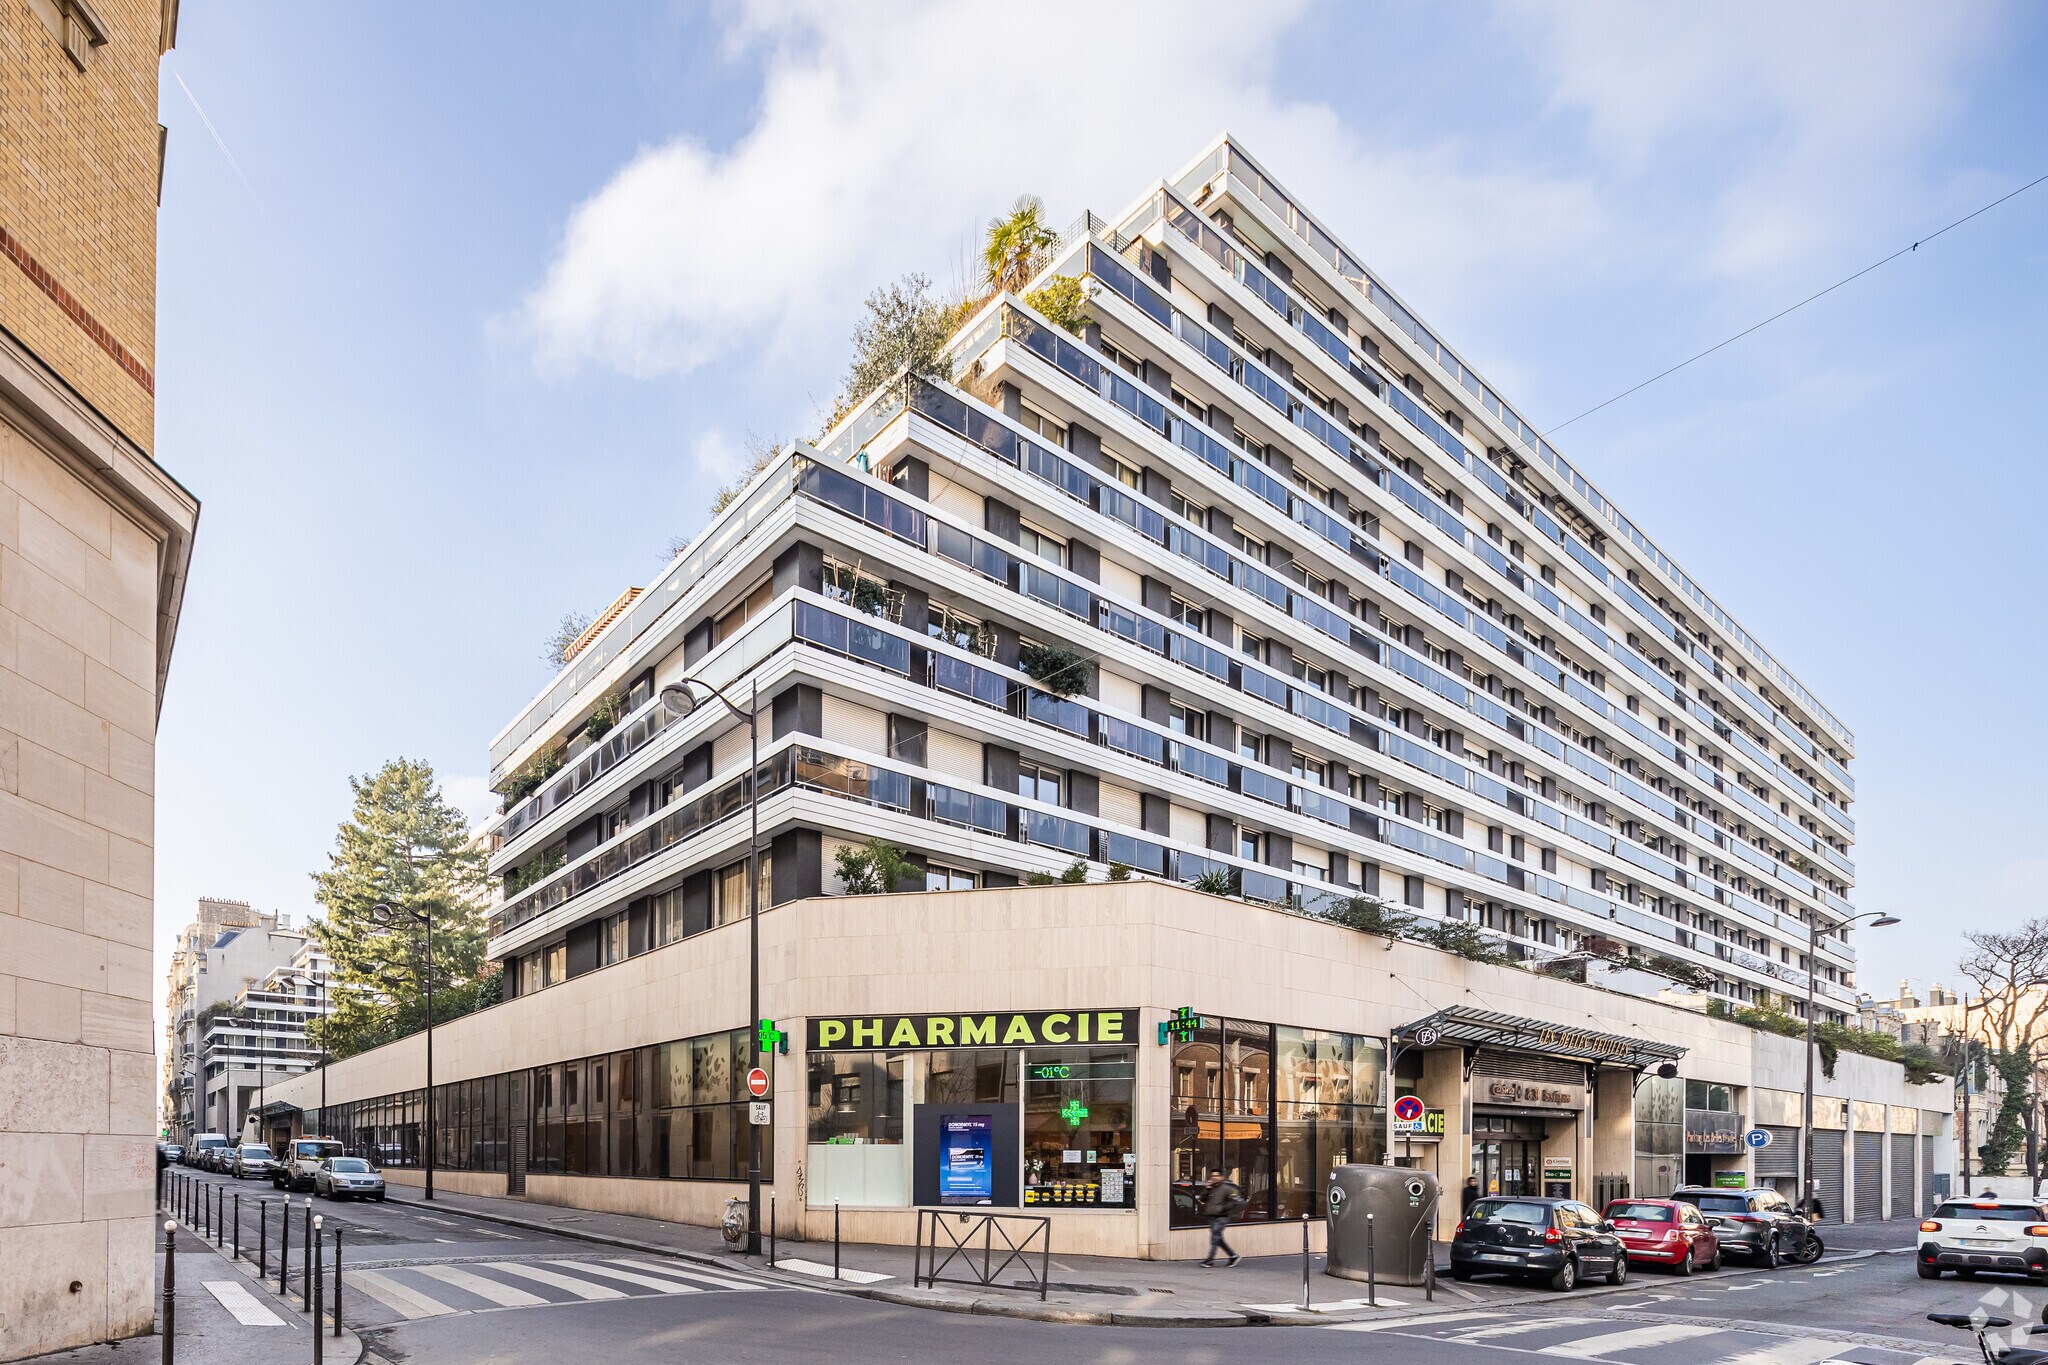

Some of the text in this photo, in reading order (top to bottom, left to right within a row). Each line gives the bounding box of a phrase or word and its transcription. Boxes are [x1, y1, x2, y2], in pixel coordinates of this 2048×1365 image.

[818, 1012, 1124, 1048] PHARMACIE
[1170, 1019, 1198, 1031] 11:44
[1538, 1028, 1556, 1045] LES
[1558, 1032, 1590, 1050] BELLES
[1751, 1133, 1763, 1145] P
